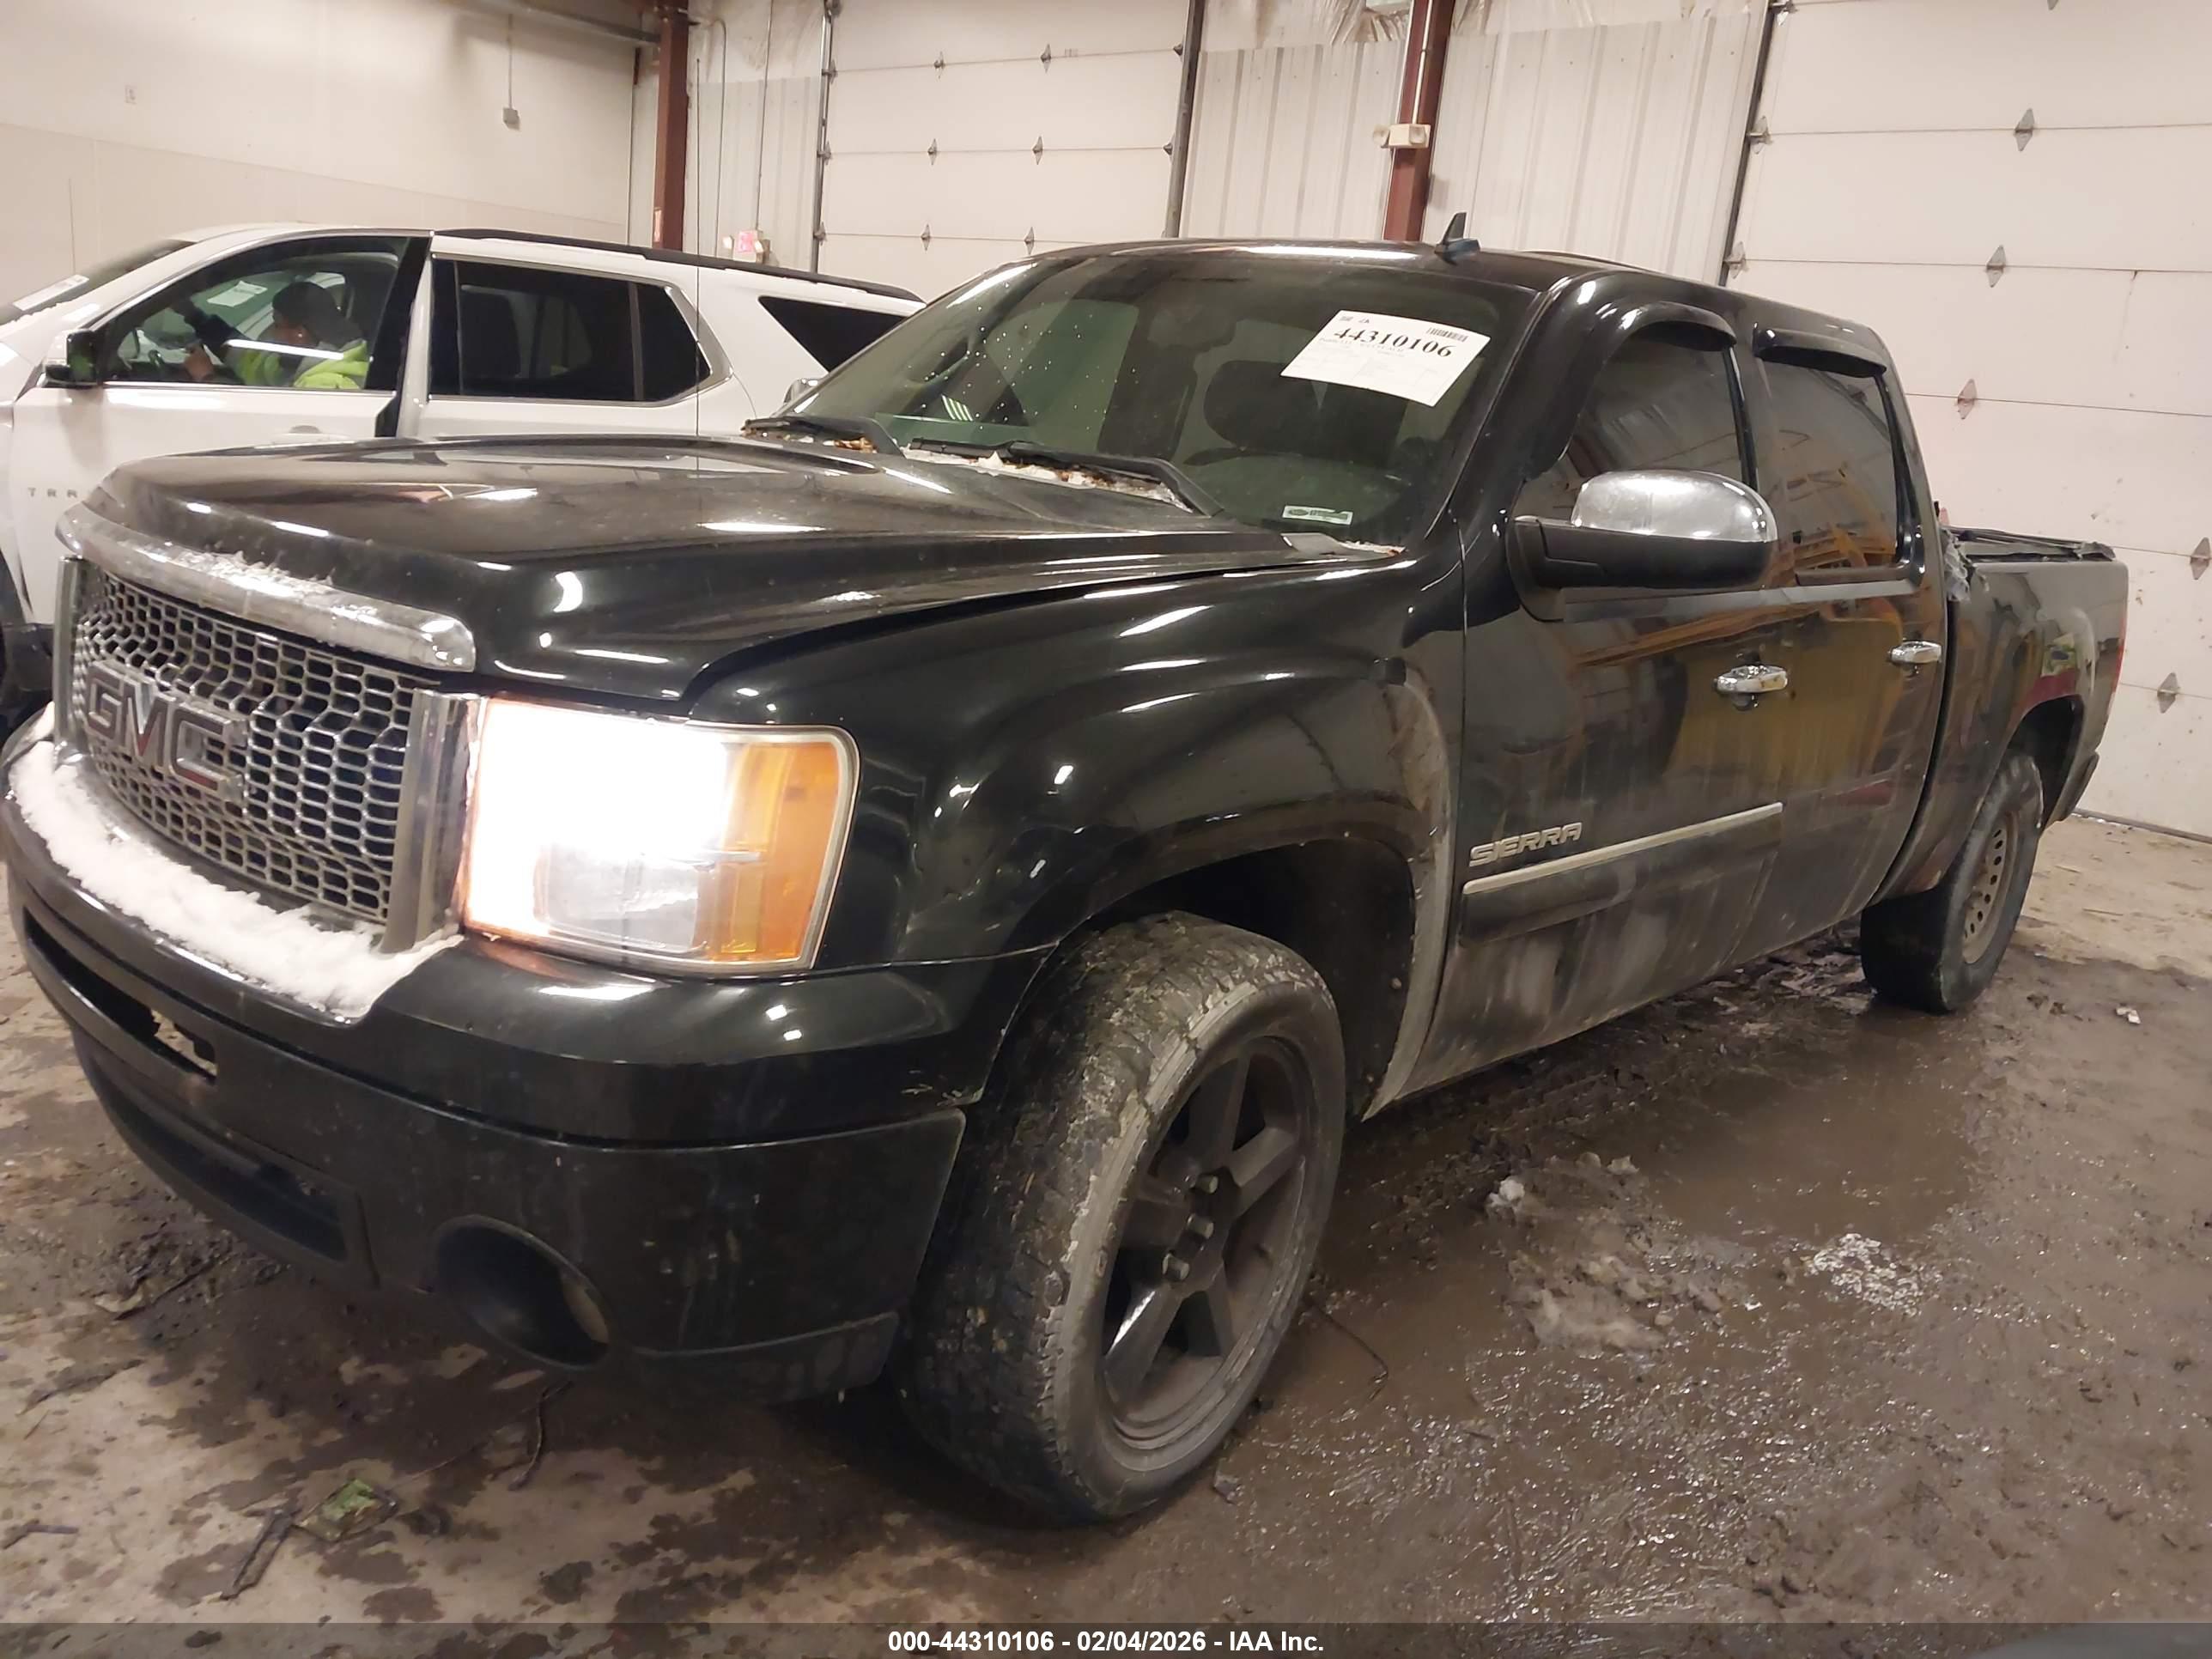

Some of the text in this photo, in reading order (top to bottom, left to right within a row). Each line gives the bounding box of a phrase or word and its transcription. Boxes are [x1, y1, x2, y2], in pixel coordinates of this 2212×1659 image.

[1334, 328, 1455, 357] 44310106
[87, 659, 246, 800] GMC
[1468, 822, 1583, 867] SIERRA
